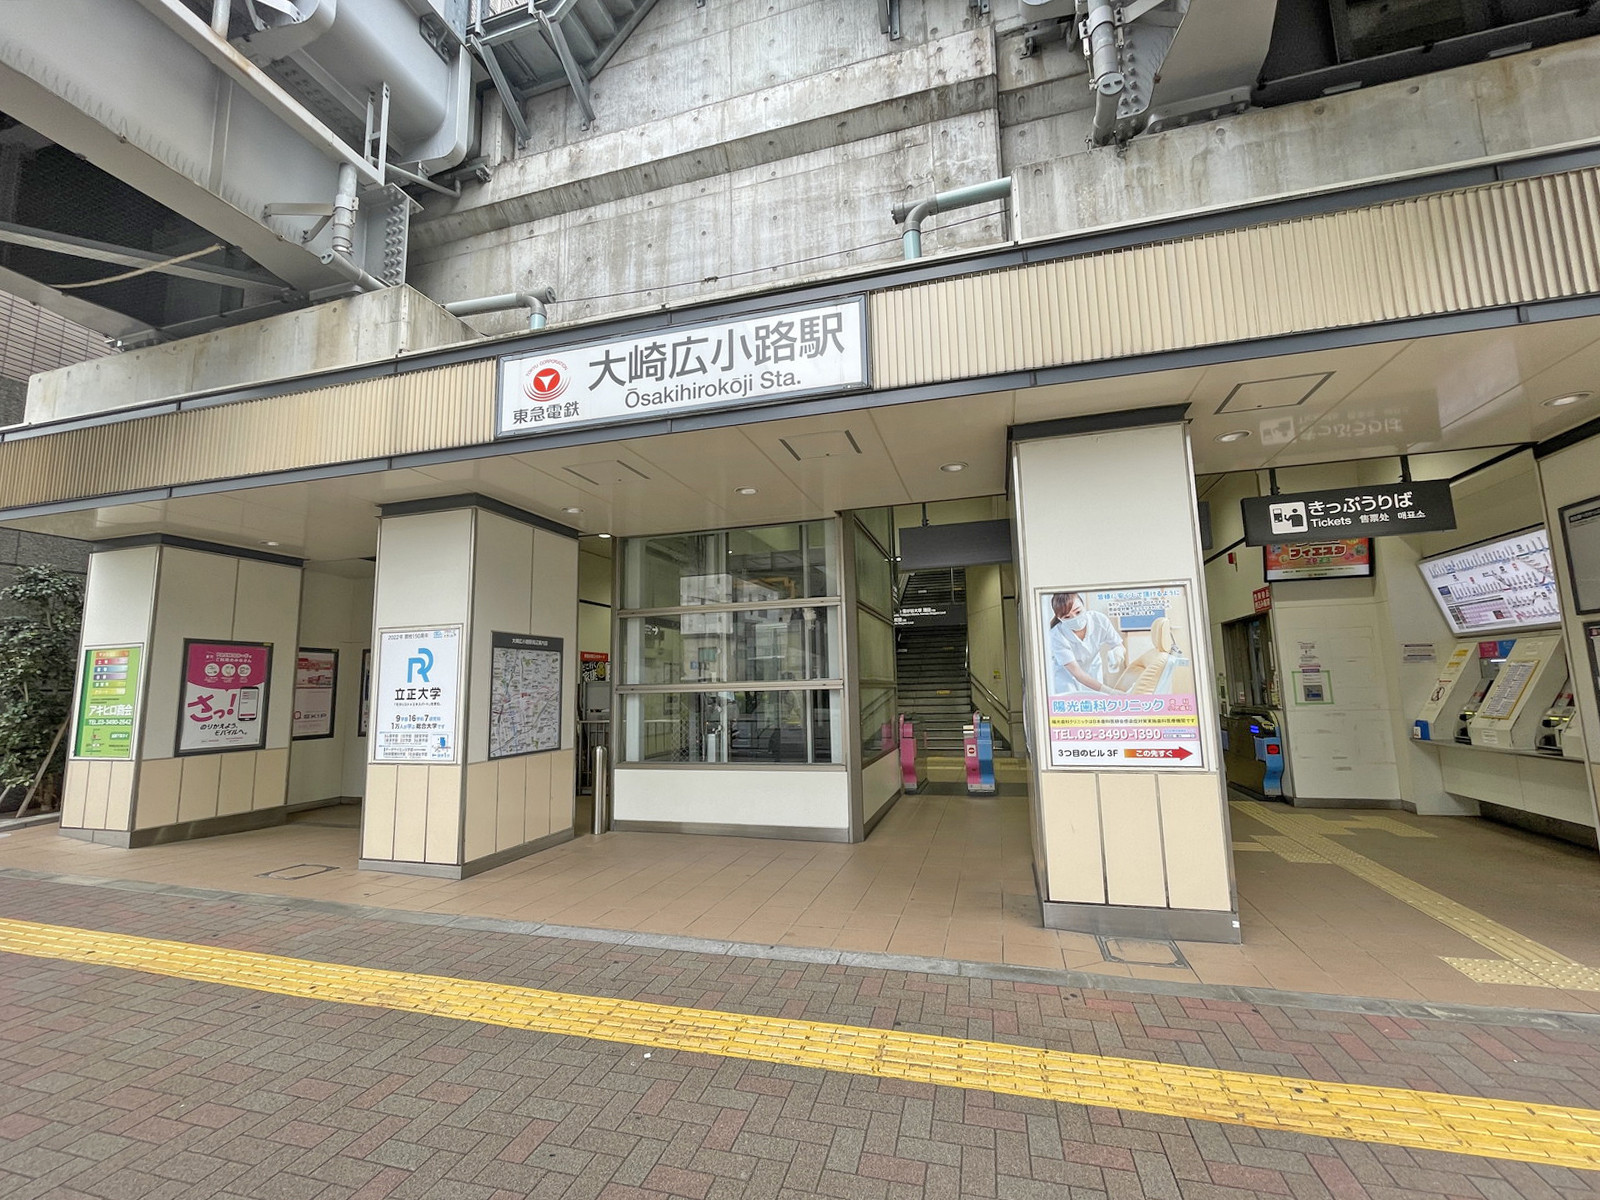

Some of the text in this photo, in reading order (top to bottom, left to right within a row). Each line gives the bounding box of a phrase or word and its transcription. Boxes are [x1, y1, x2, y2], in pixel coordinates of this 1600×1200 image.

[588, 311, 845, 392] 大崎広小路駅
[625, 370, 802, 409] Ōsakihirokōji Sta.
[512, 400, 580, 425] 東急電鉄
[1308, 491, 1414, 516] きっぷうりば
[1310, 516, 1352, 528] Tickets
[1359, 512, 1390, 524] 售票处
[394, 686, 442, 701] 立正大学
[88, 703, 133, 717] アキヒロ商会
[1052, 699, 1164, 714] 陽光歯科クリニック
[1058, 748, 1119, 758] 3つ目のビル 3F
[1136, 749, 1173, 759] この先すぐ
